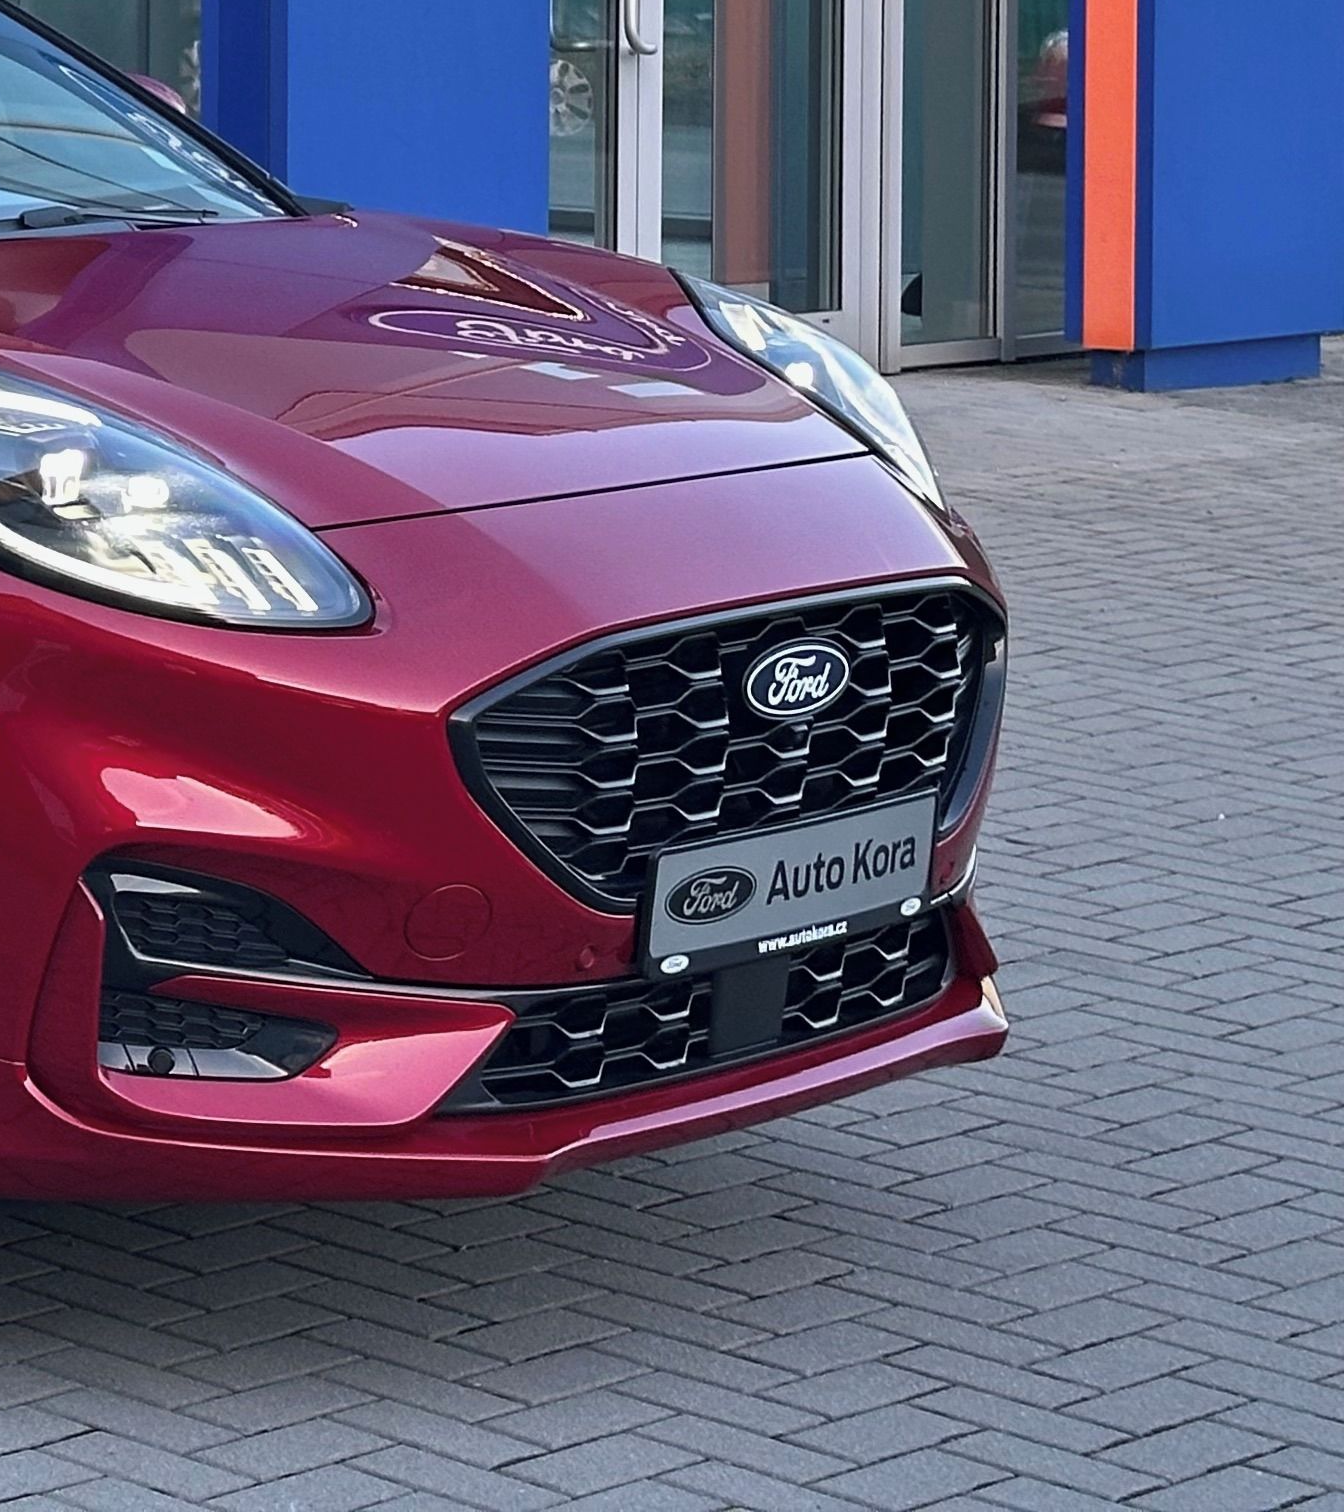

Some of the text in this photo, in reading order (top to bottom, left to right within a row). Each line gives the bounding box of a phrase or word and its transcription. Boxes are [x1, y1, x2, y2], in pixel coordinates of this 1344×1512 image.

[768, 655, 831, 705] Ford
[683, 836, 916, 916] Ford Auto Kora
